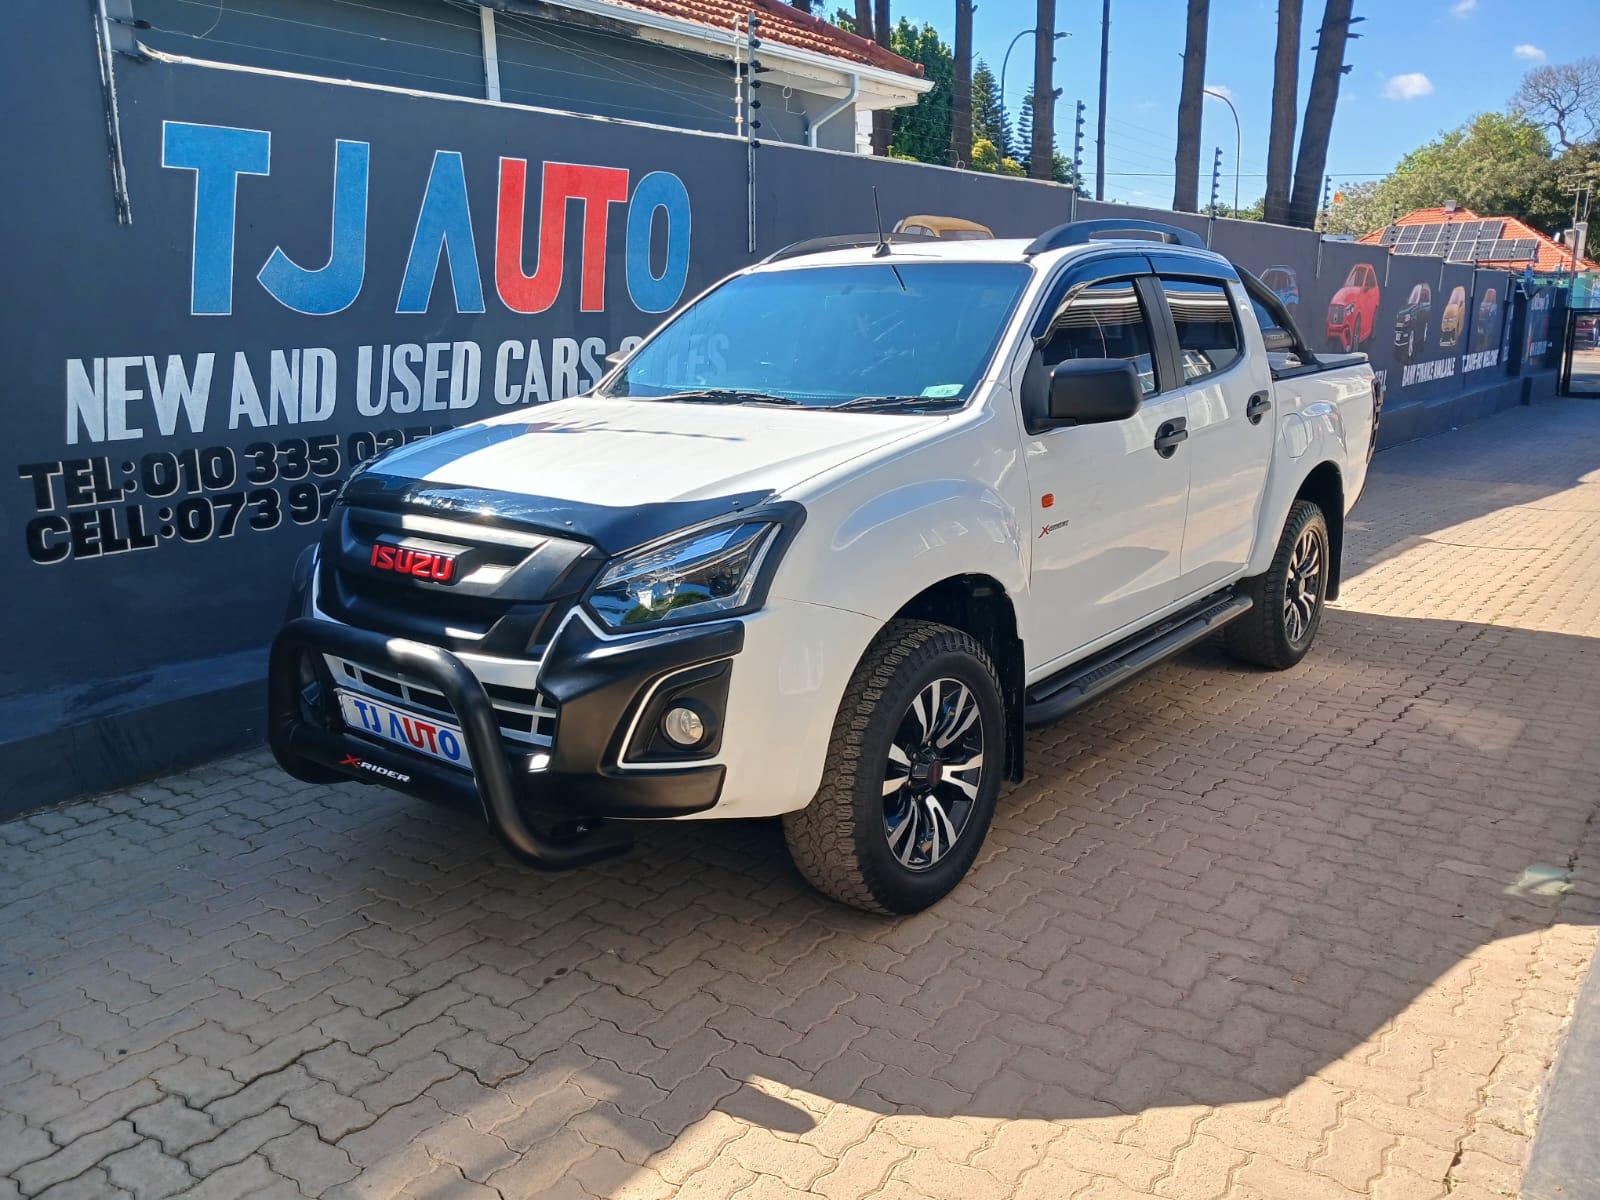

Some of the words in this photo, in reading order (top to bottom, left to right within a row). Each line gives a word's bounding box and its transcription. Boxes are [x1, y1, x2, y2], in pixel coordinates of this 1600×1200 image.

[161, 120, 370, 317] TJ
[395, 149, 692, 315] AUTO
[66, 352, 216, 445] NEW
[228, 347, 338, 431] AND
[356, 340, 481, 418] USED
[494, 337, 606, 405] CARS
[18, 445, 238, 513] TEL:010
[246, 433, 341, 485] 335
[26, 486, 282, 566] CELL:073
[370, 544, 455, 582] ISUZU
[339, 753, 411, 783] X-RIDER
[354, 699, 383, 733] TJ
[389, 718, 461, 761] AUTO
